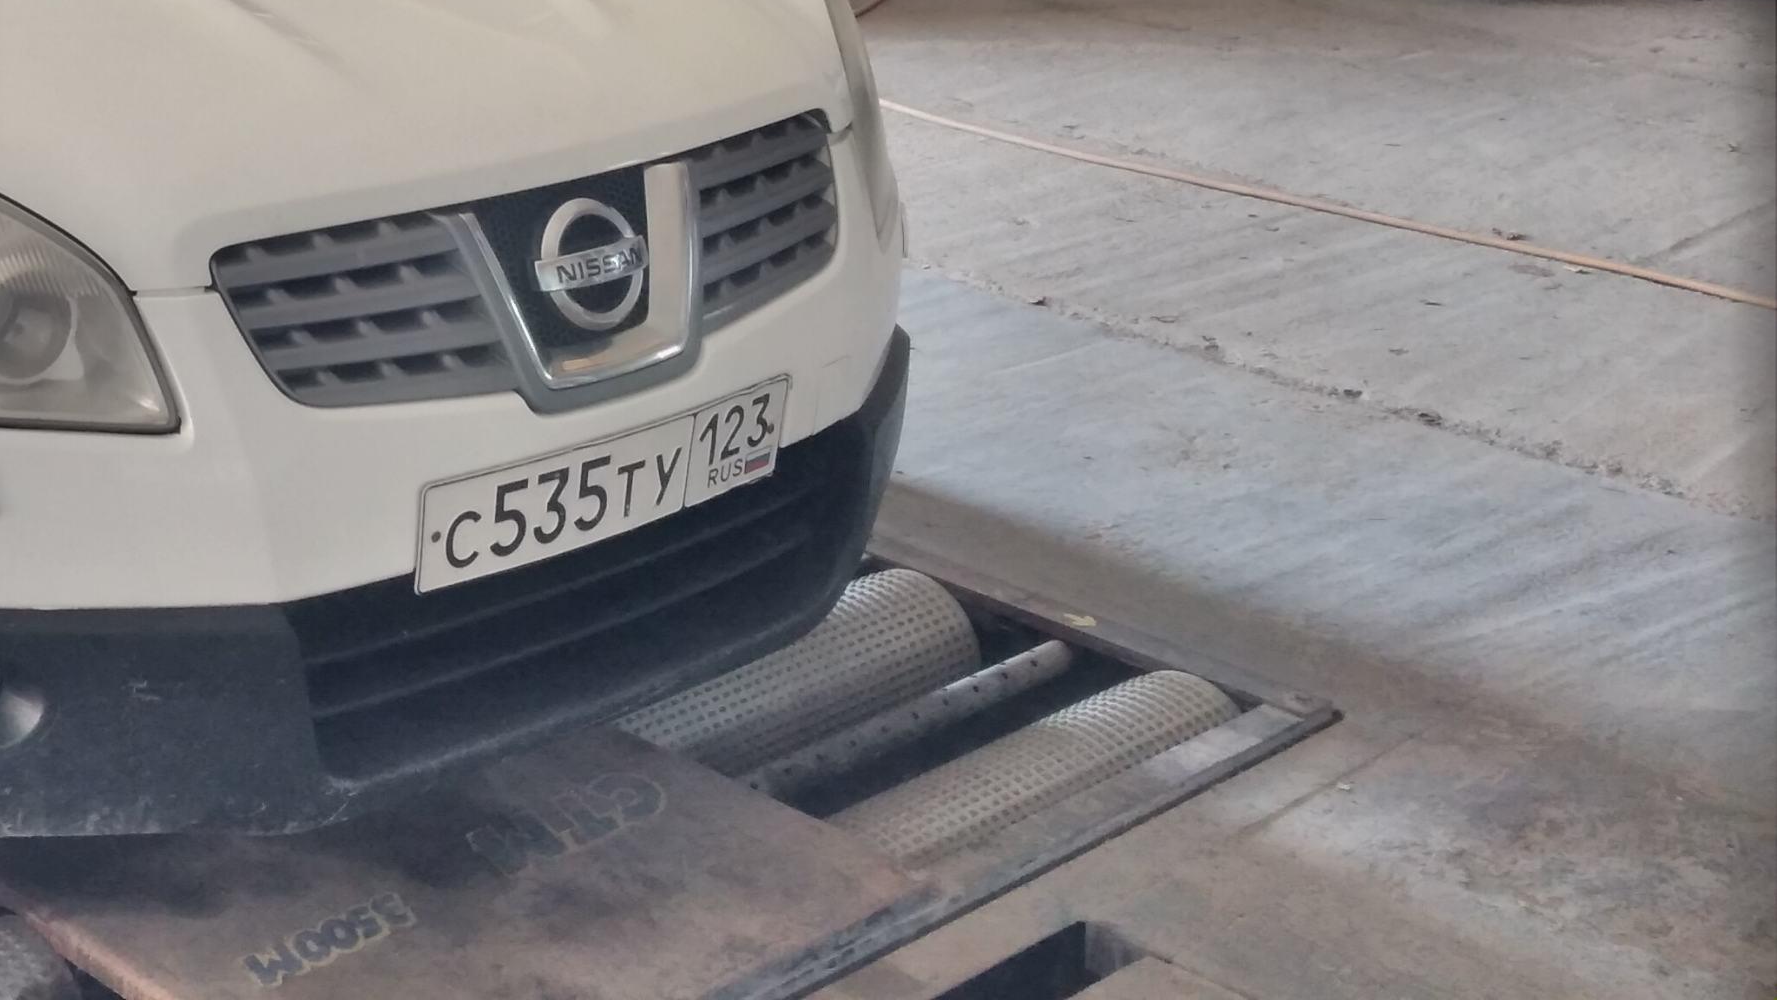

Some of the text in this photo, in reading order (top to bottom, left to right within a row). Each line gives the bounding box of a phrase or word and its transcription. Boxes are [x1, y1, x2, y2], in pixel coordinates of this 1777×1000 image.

[556, 247, 643, 283] NISSAN
[445, 394, 771, 569] С535ТУ 123
[708, 459, 744, 489] RUS
